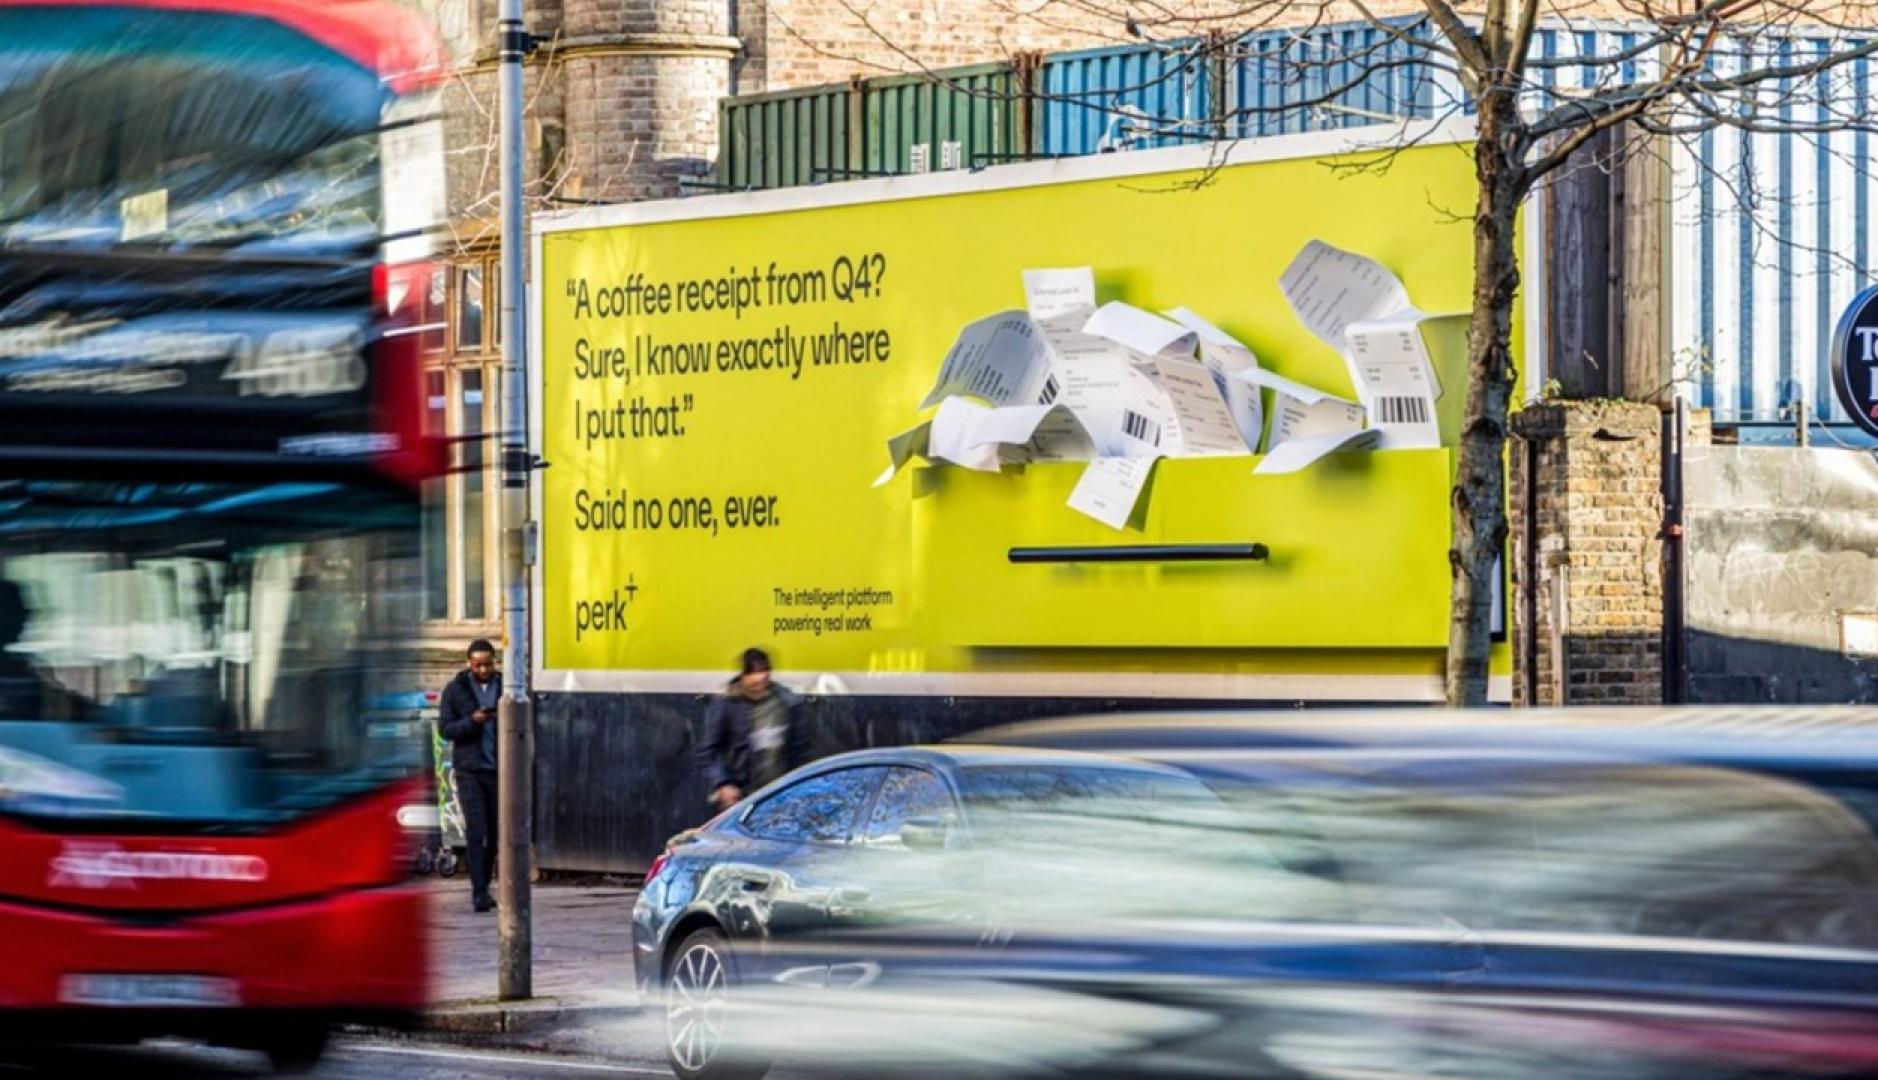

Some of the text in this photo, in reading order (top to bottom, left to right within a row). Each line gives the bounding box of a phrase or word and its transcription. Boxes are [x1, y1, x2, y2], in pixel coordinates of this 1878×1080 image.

[596, 272, 671, 317] coffee
[677, 266, 761, 319] receipt
[766, 262, 826, 304] from
[831, 252, 887, 303] Q4?
[575, 338, 630, 384] Sure,
[636, 335, 641, 376] I
[647, 335, 712, 376] know
[717, 324, 806, 379] exactly
[812, 322, 891, 366] where
[575, 399, 580, 439] I
[587, 397, 625, 450] put
[575, 488, 780, 536] Said no one, ever.
[773, 587, 893, 611] The intelligent platform
[773, 614, 872, 636] powering real work
